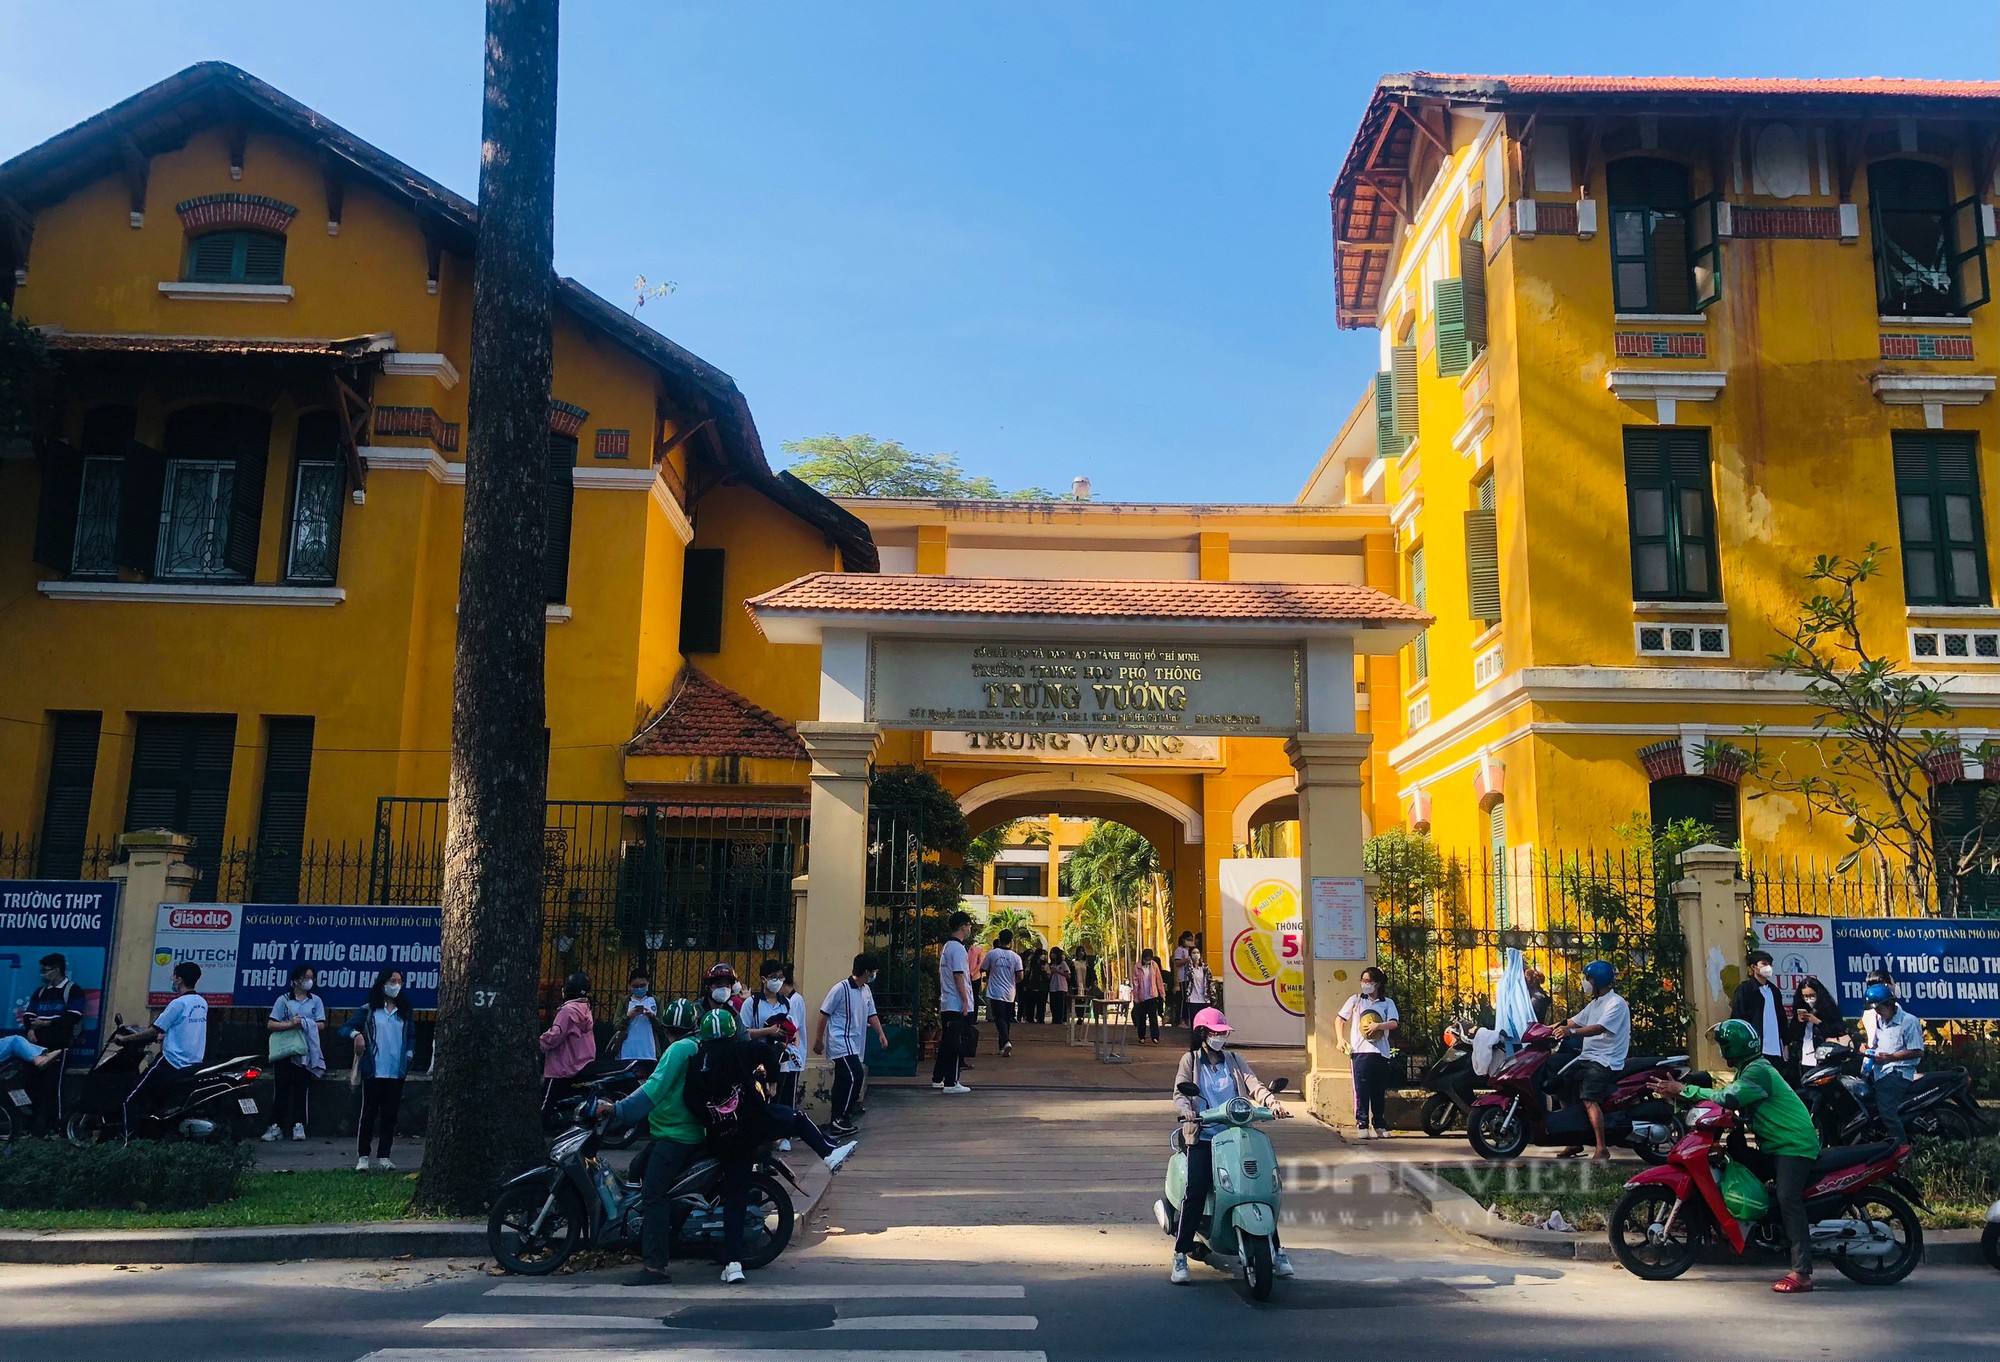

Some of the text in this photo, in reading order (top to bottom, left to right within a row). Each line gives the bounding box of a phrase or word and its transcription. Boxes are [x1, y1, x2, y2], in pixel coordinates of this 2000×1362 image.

[1177, 652, 1200, 662] MINH
[1030, 664, 1077, 679] TRUNG
[1083, 666, 1113, 682] HỌC
[1154, 664, 1201, 681] THÔNG
[1092, 680, 1187, 711] VƯƠNG
[4, 890, 102, 910] TRƯỜNG THPT
[0, 911, 101, 930] TRƯNG VƯƠNG
[173, 911, 228, 928] giáo dục
[329, 916, 347, 928] TẠO
[1768, 924, 1820, 942] giáo dục
[1849, 926, 1871, 938] GIÁO
[1873, 928, 1891, 940] DỤC
[1917, 929, 1936, 941] TẠO
[1936, 926, 1967, 939] THÀNH
[174, 949, 237, 961] HUTECH
[252, 940, 441, 964] MỘT Ý THỨC GIAO THÔNG
[1883, 953, 1894, 973] Ý
[1897, 953, 1940, 974] THỨC
[1943, 955, 1979, 974] GIAO
[242, 966, 288, 990] TRIỆU
[316, 967, 356, 988] CƯỜI
[406, 969, 440, 989] PHÚ
[474, 990, 497, 1007] 37
[1915, 979, 1954, 999] CƯỜI
[1957, 983, 1999, 1003] HẠNH
